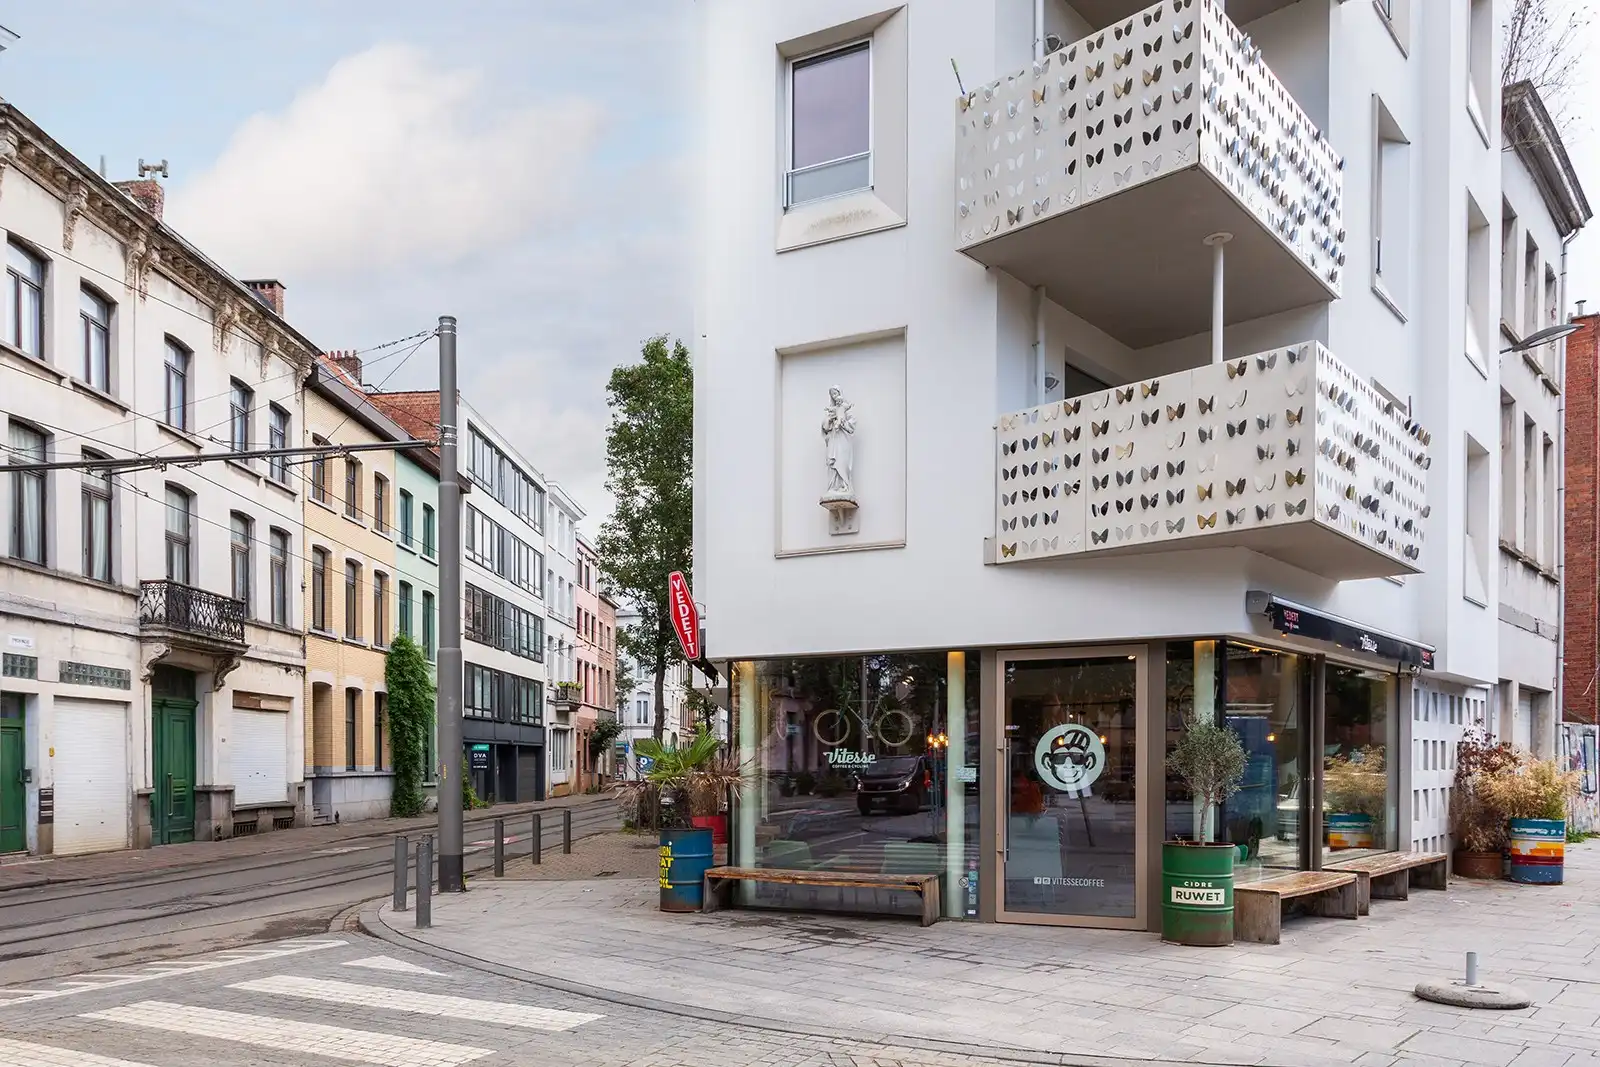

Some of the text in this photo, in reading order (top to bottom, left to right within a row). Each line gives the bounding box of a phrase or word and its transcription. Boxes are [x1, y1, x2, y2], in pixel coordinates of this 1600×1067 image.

[672, 579, 695, 655] VEDETT
[822, 748, 877, 764] Vitesse
[659, 856, 674, 868] AT
[1051, 877, 1105, 888] VITESSECOFFEE
[1175, 890, 1220, 901] RUWET
